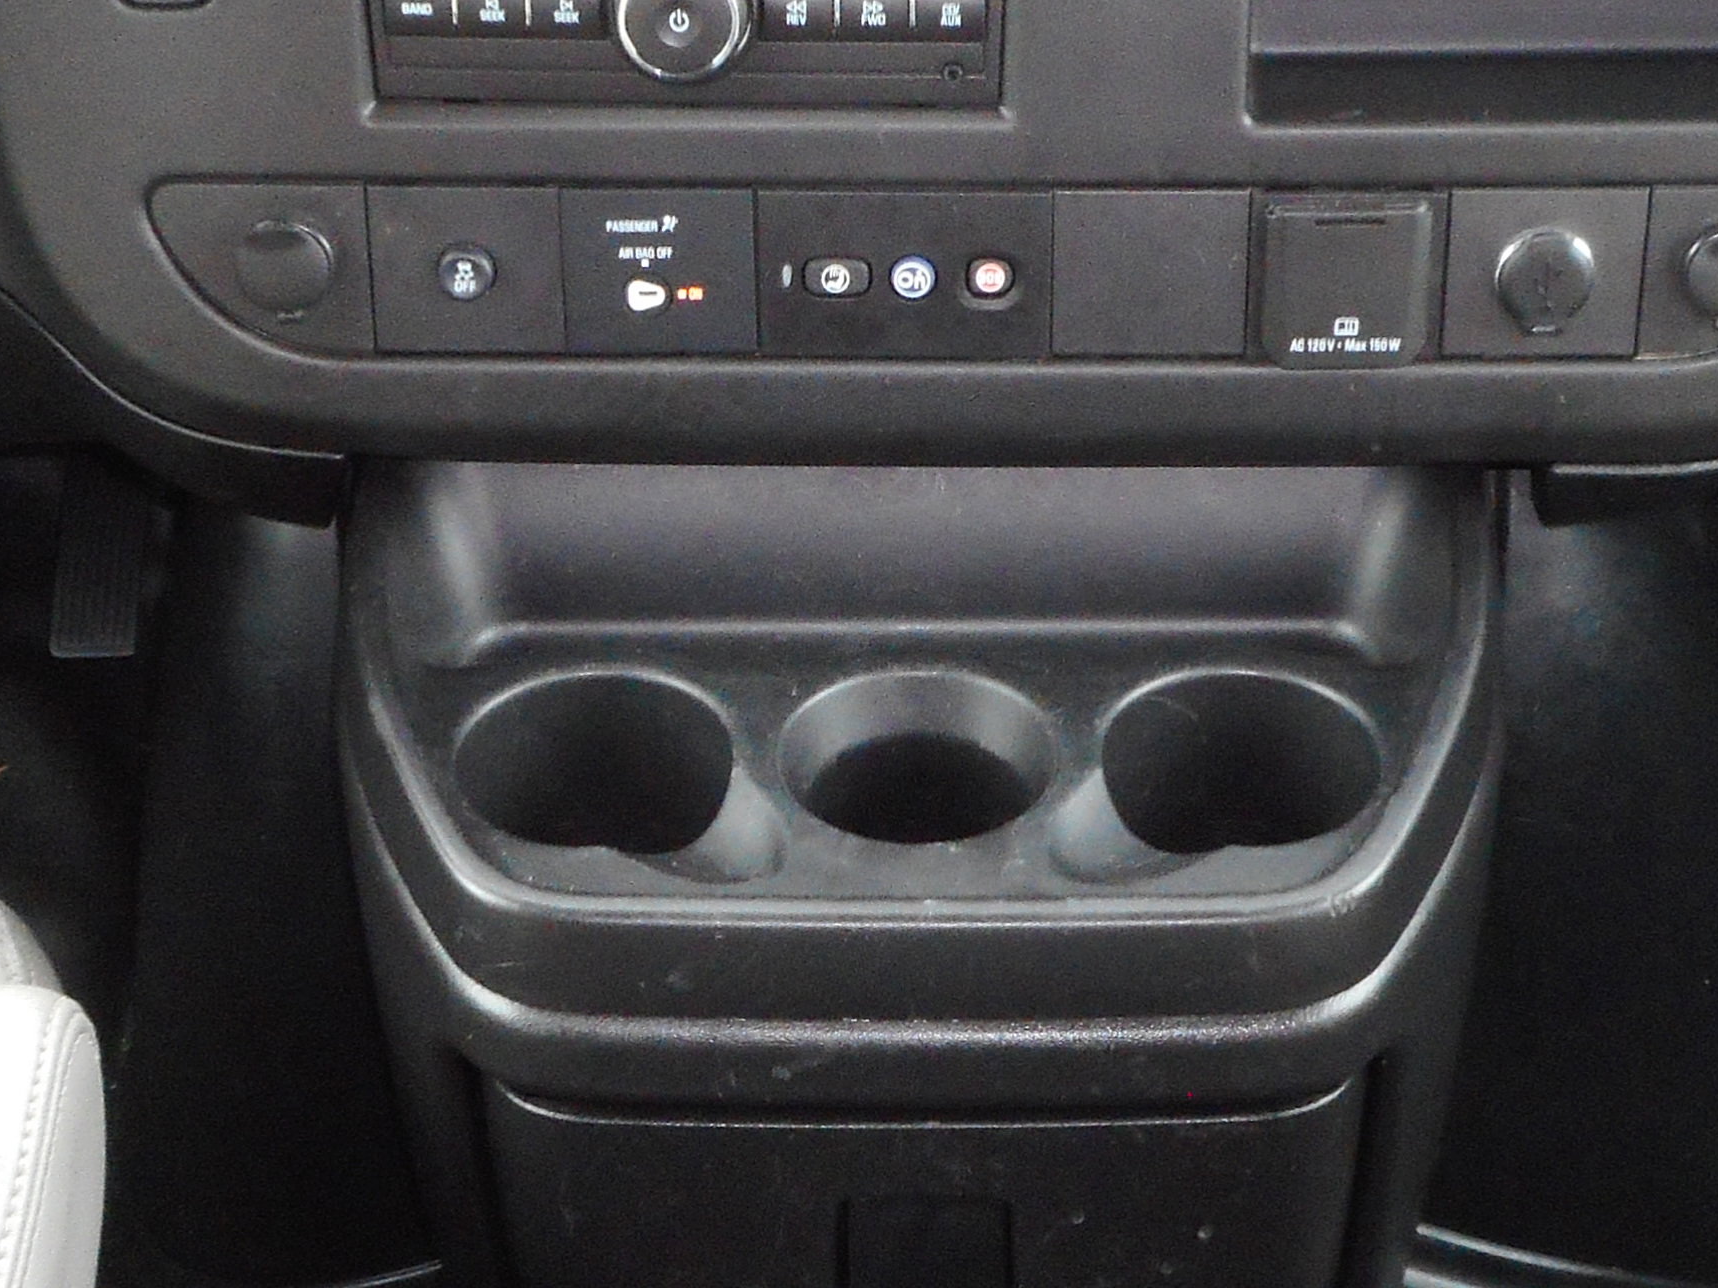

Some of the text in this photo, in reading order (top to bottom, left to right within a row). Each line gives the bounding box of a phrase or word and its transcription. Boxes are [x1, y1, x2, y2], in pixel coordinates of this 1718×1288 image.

[401, 2, 434, 17] BAND
[479, 9, 507, 23] SEEK
[553, 10, 580, 25] SEEK
[786, 13, 808, 27] REV
[861, 13, 887, 27] FWD
[940, 14, 962, 27] AUX
[605, 219, 659, 233] PASSENGER
[656, 246, 673, 260] OFF
[454, 280, 476, 293] OFF
[1289, 338, 1305, 353] AC
